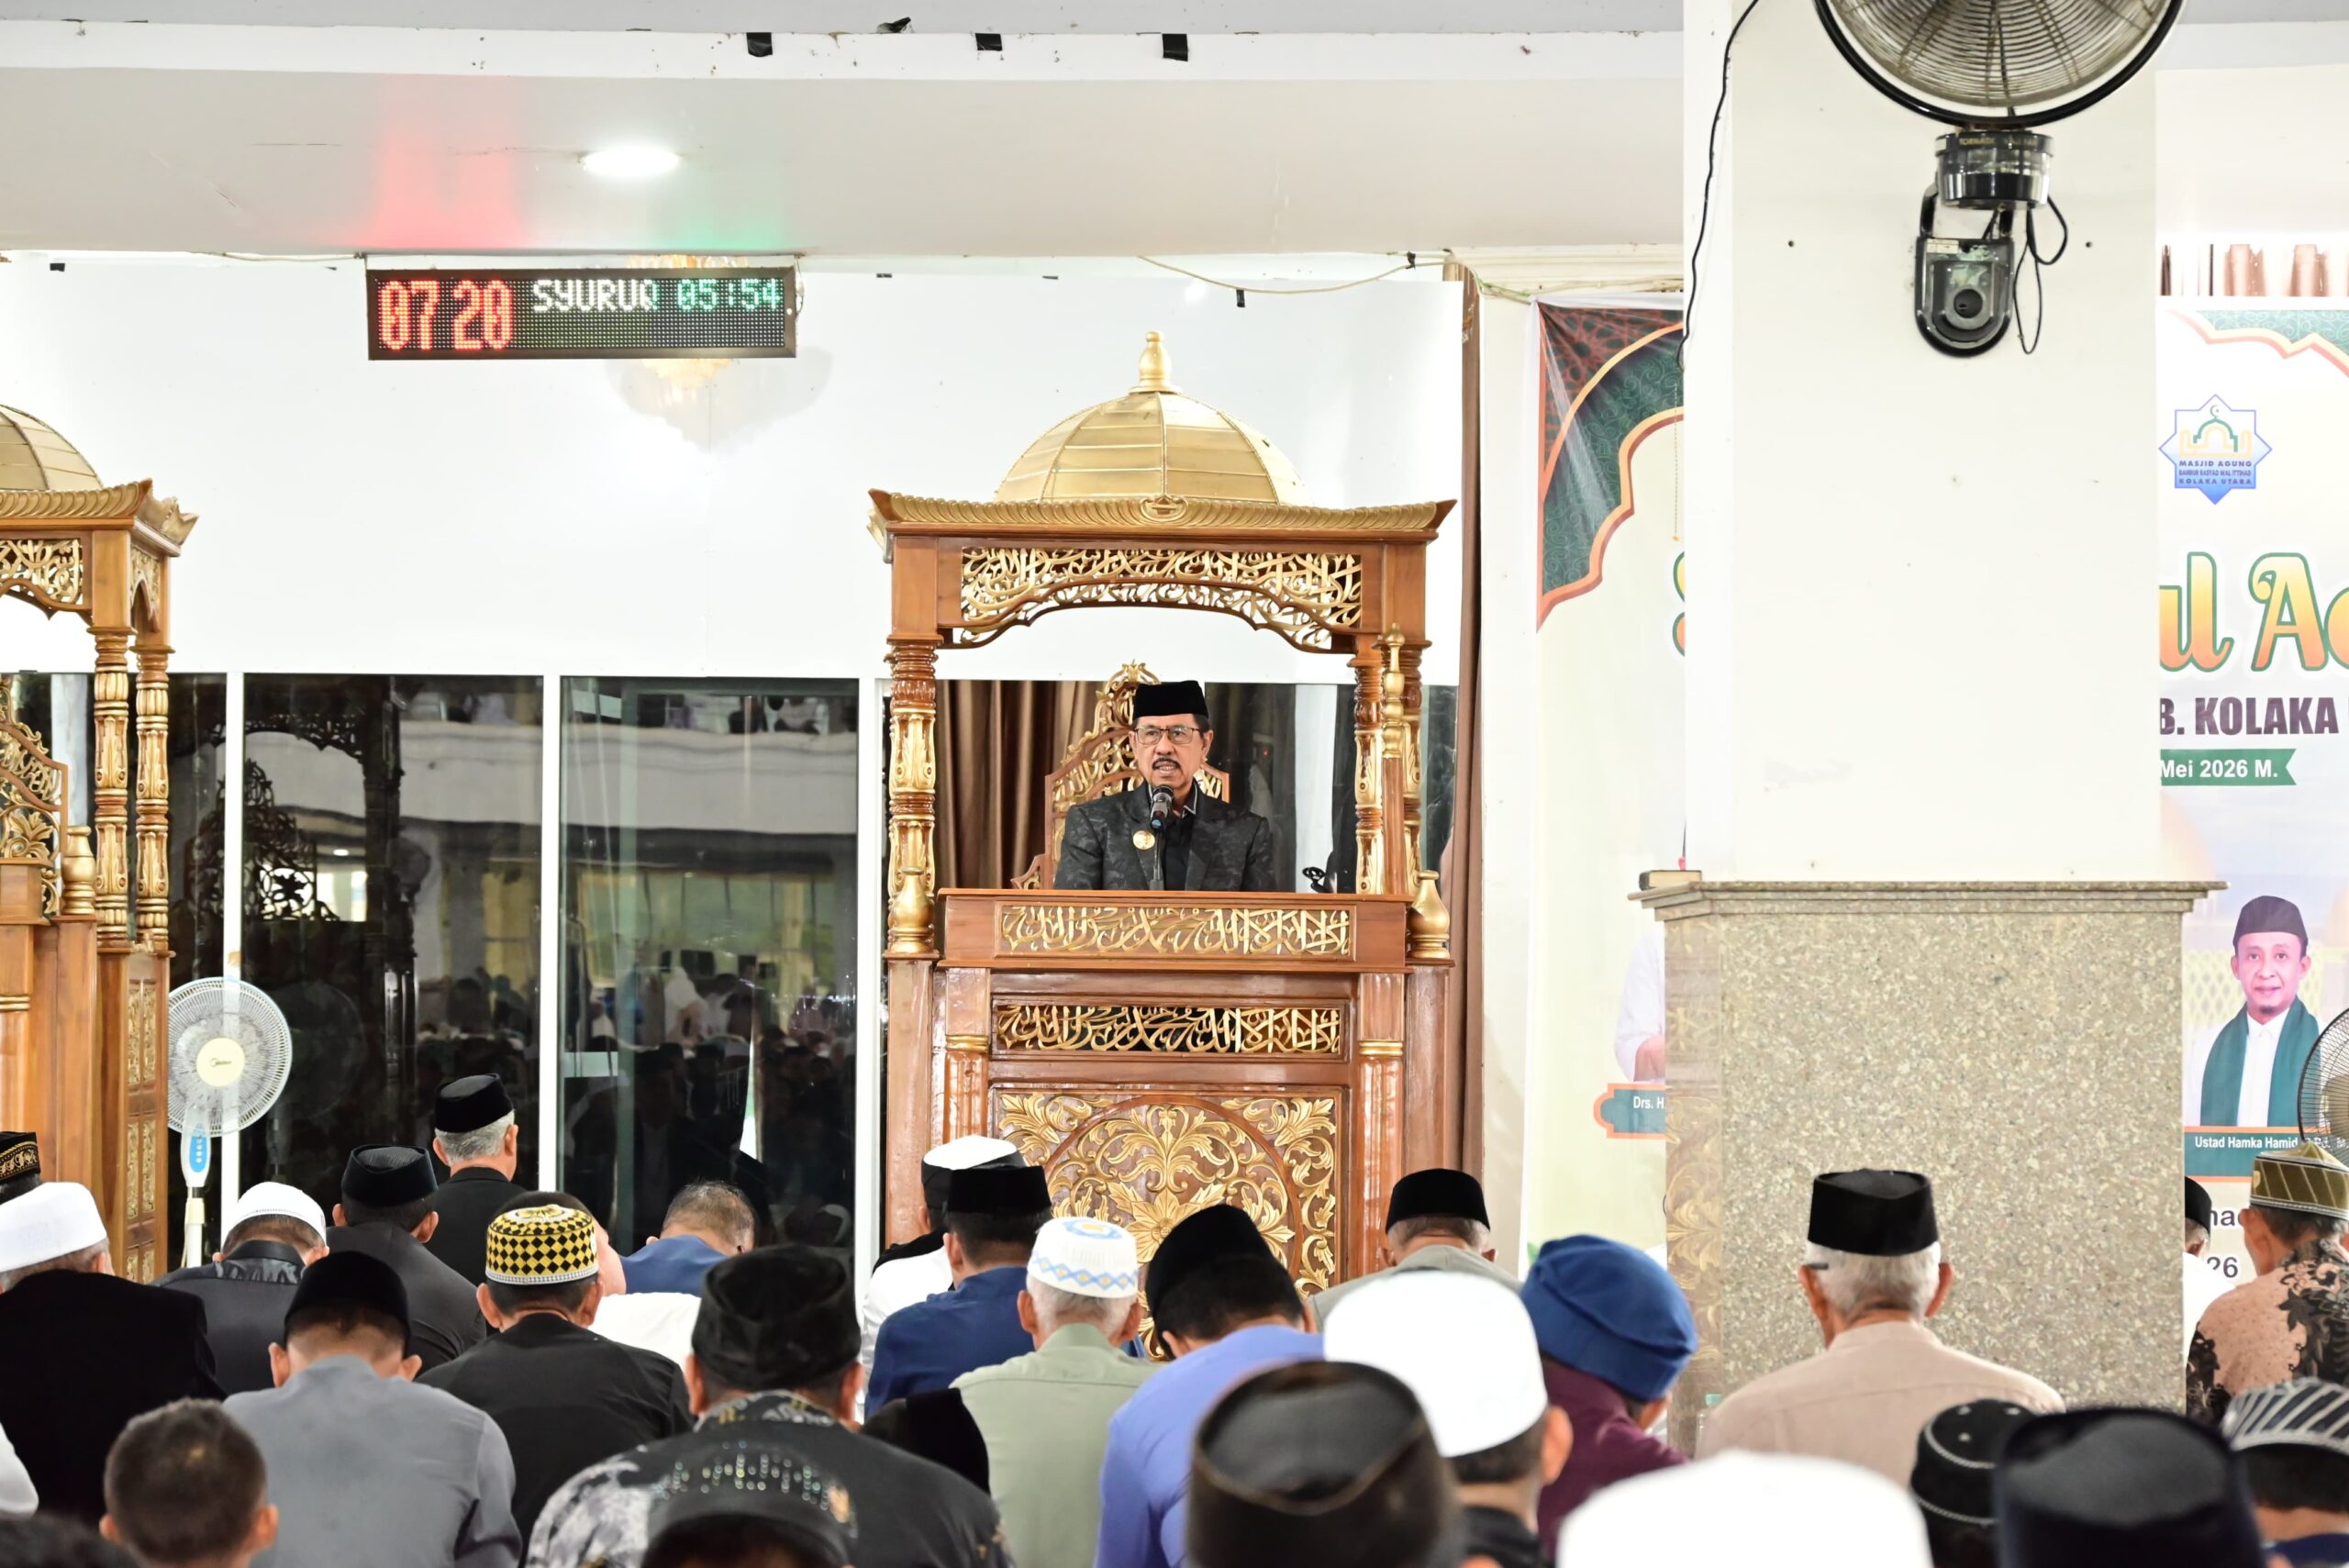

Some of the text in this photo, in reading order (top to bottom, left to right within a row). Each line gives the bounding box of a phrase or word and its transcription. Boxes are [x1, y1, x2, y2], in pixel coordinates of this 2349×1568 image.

[2195, 696, 2339, 736] KOLAKA
[2160, 759, 2278, 778] Mei 2026 M.
[1633, 1095, 1653, 1109] Drs.
[2195, 1136, 2225, 1148] Ustad
[2228, 1136, 2263, 1149] Hamka
[2266, 1136, 2298, 1149] Hamid
